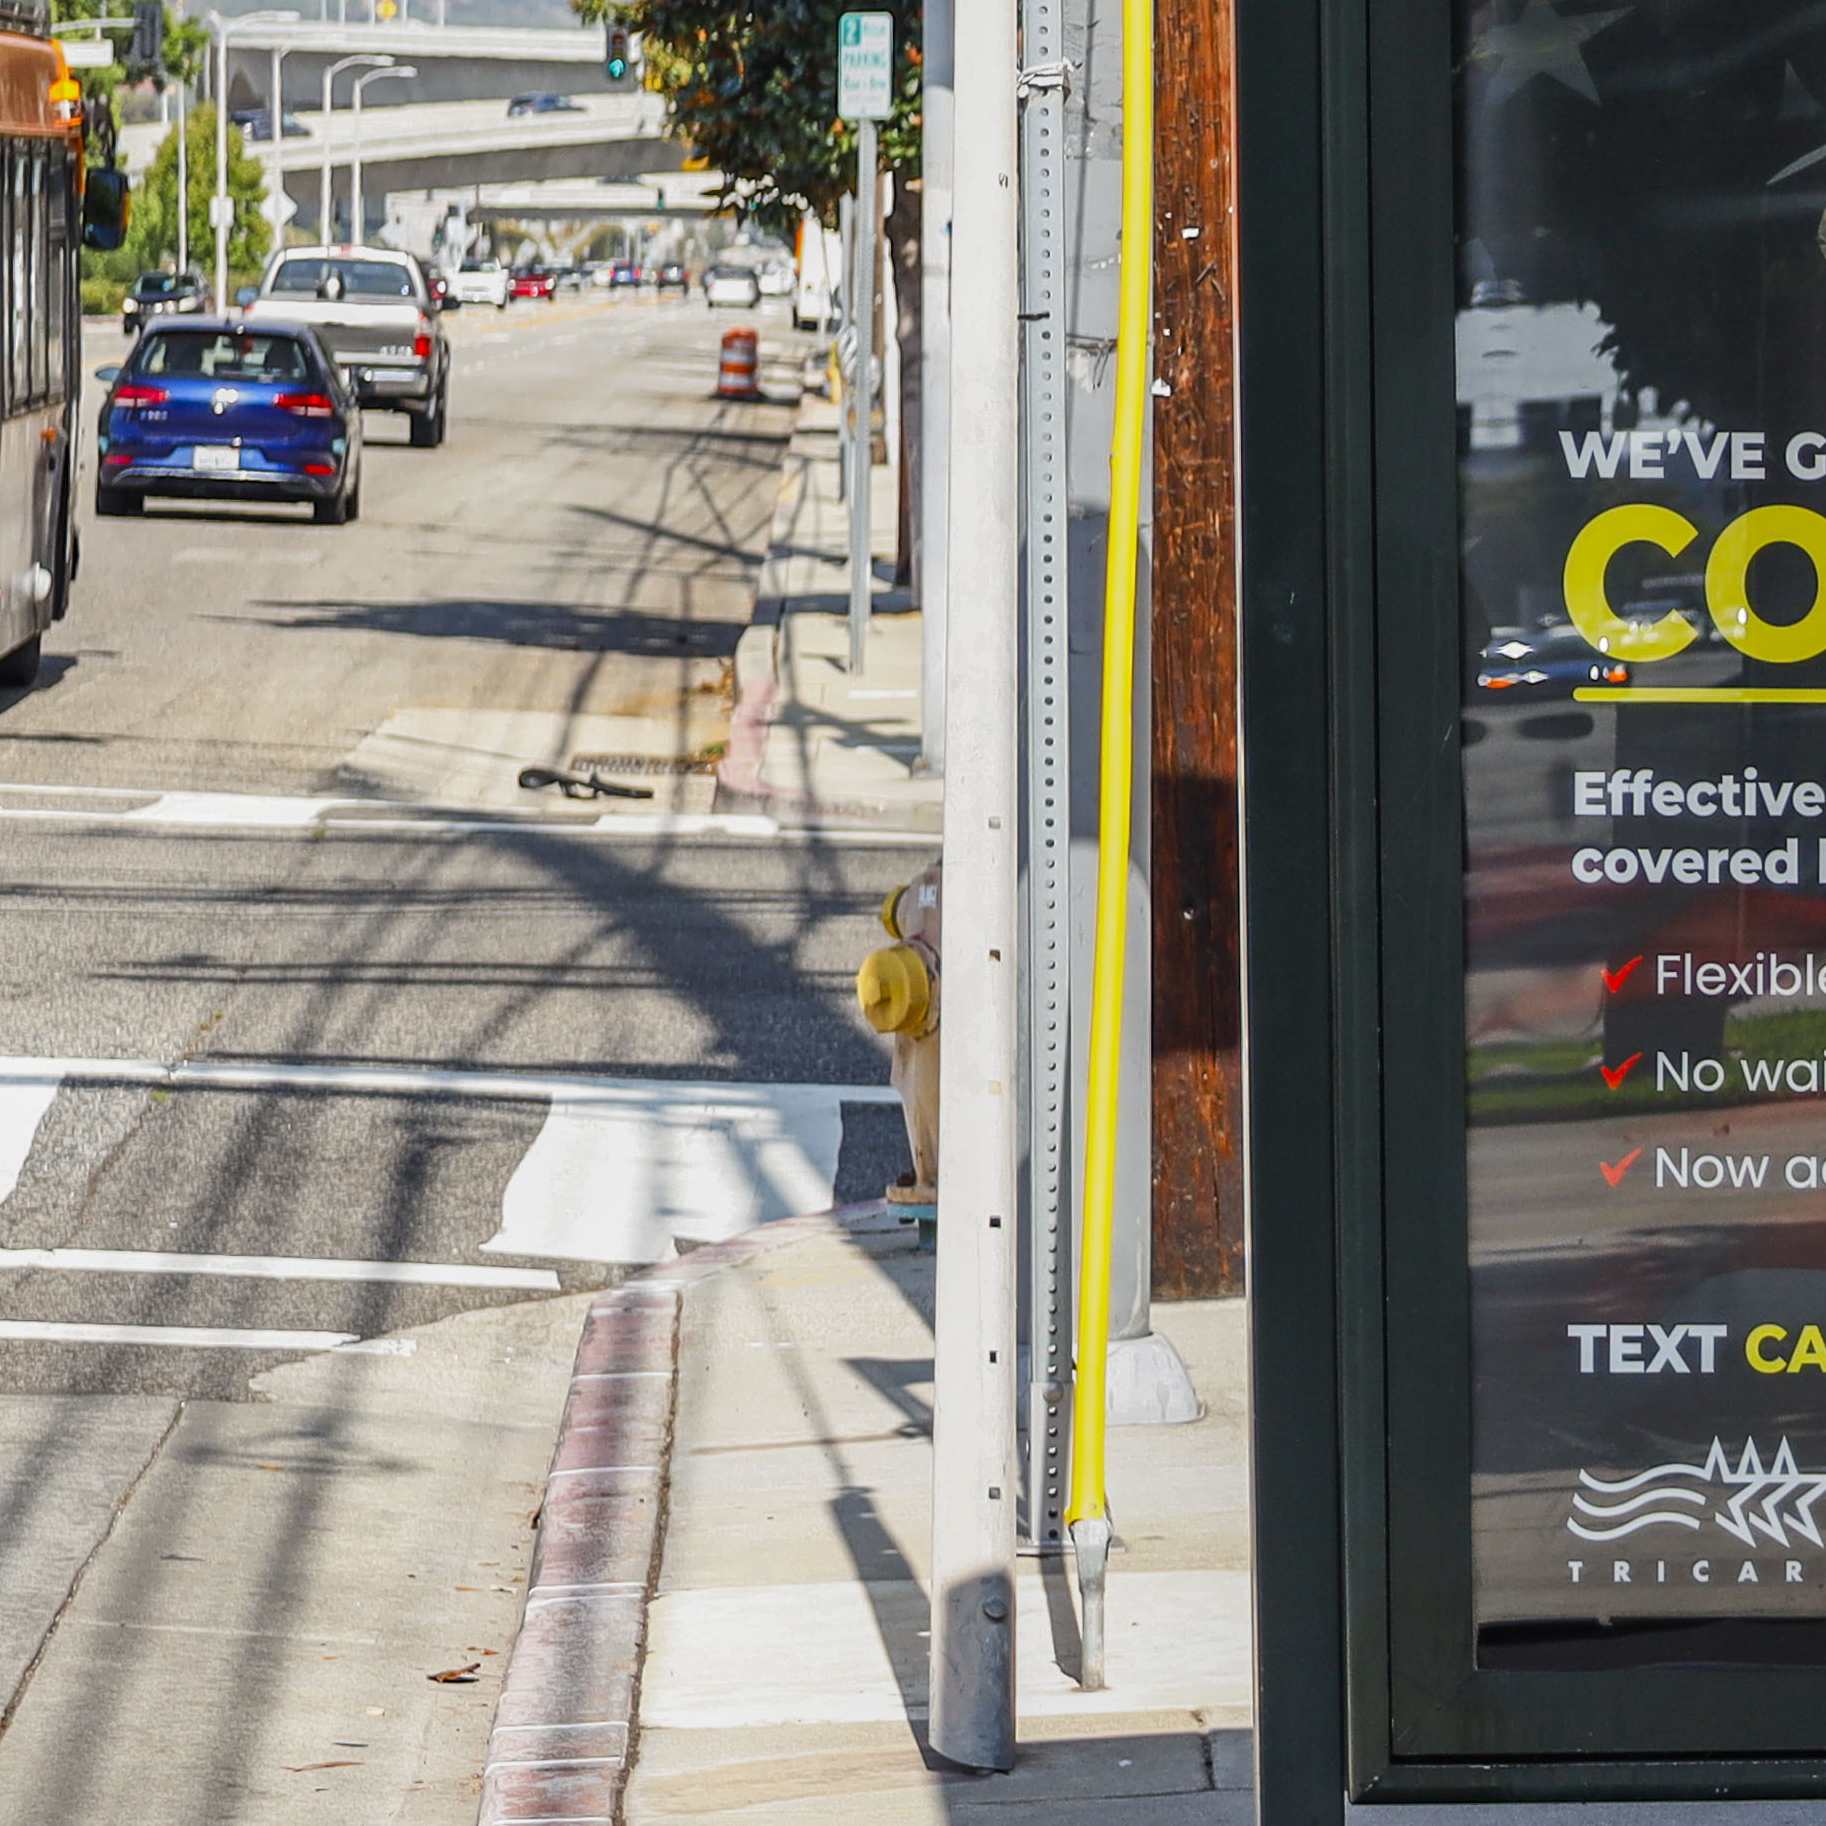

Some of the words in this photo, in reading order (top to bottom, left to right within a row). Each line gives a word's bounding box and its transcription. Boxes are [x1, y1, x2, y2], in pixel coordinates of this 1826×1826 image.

[1559, 430, 1766, 480] WE'VE
[1573, 767, 1826, 818] Effective
[1571, 837, 1799, 886] covered
[1656, 1051, 1725, 1093] No
[1656, 1147, 1770, 1189] Now
[1567, 1324, 1728, 1375] TEXT
